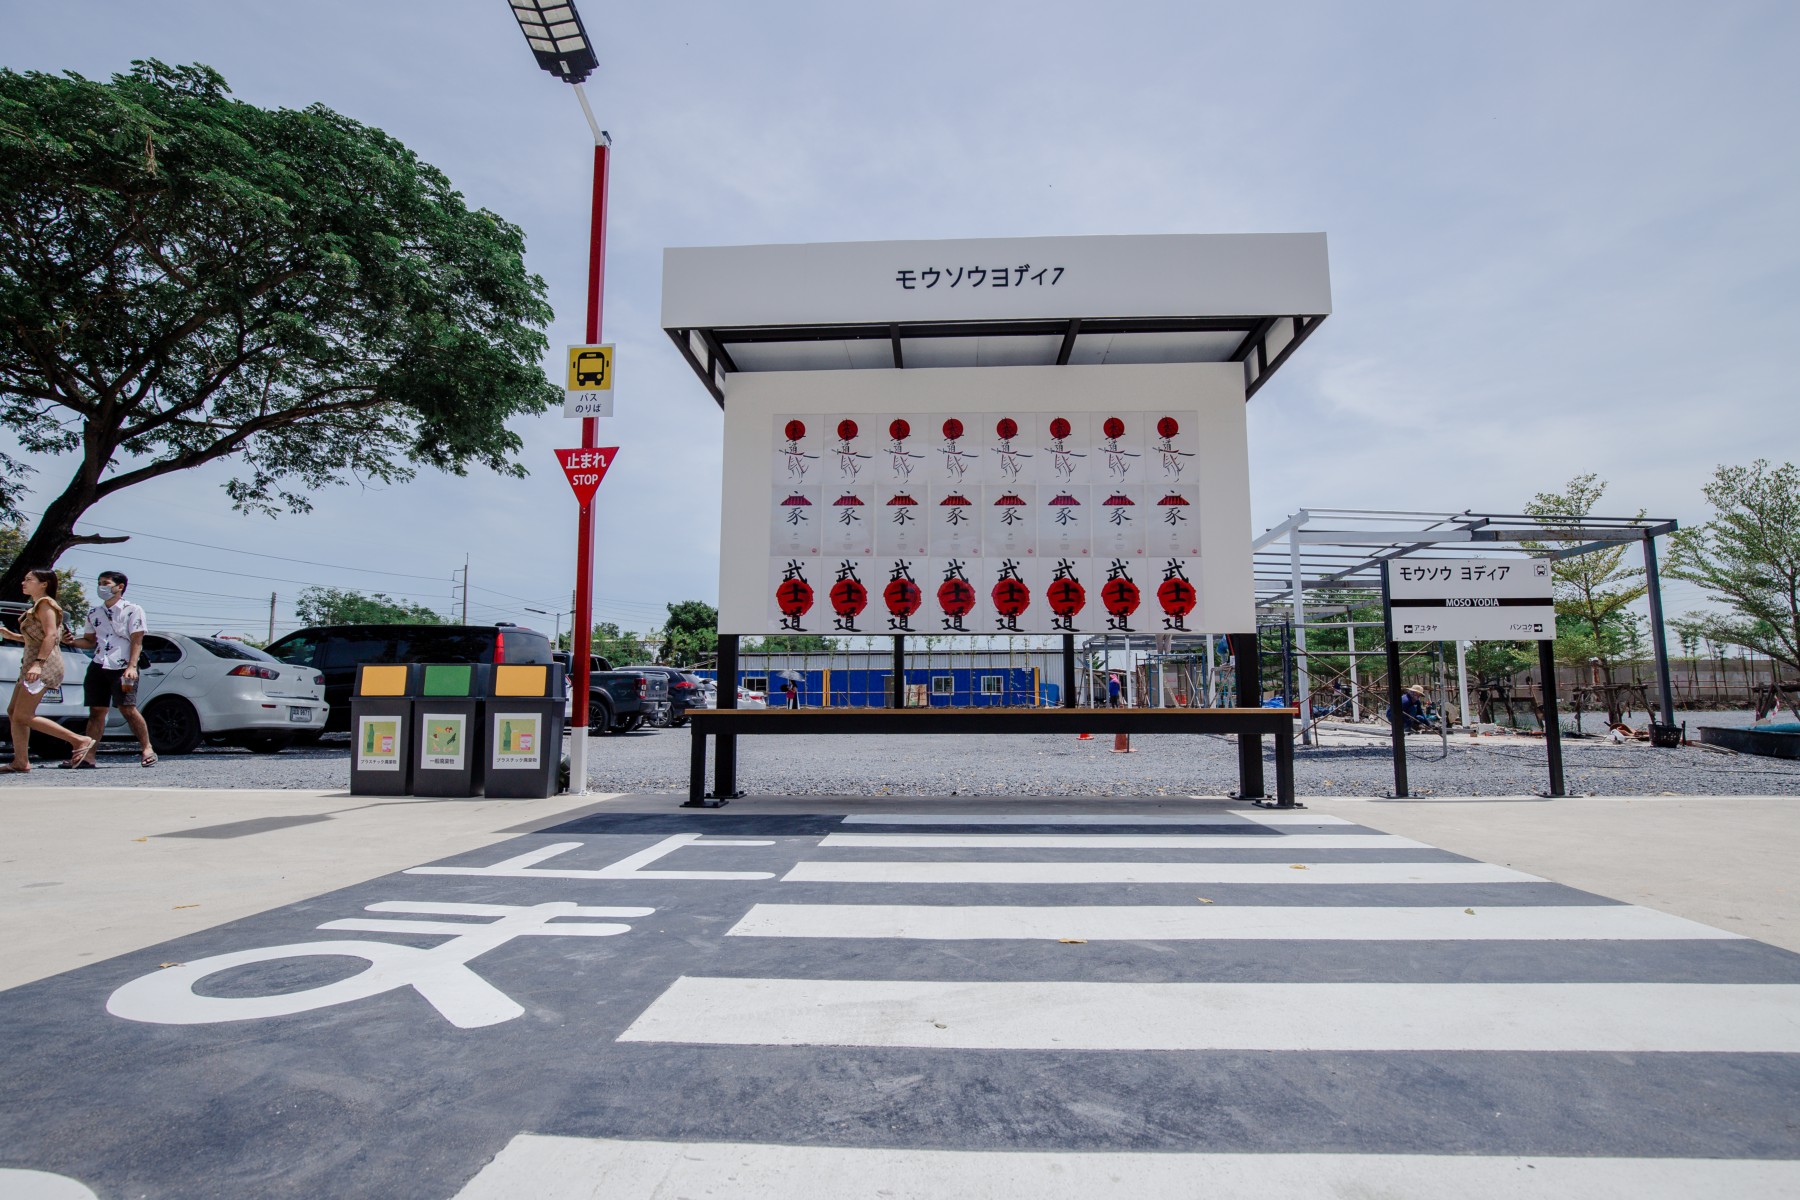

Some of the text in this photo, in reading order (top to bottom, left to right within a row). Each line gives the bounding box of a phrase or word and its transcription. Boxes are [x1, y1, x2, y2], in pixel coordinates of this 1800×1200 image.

[579, 393, 598, 402] バス
[575, 403, 602, 413] のりば
[565, 452, 607, 469] 止まれ
[572, 473, 600, 487] STOP
[1399, 565, 1511, 581] モウソウ ヨディア
[1445, 598, 1500, 607] MOSO YODIA
[1414, 624, 1438, 632] アユタヤ
[1509, 623, 1533, 631] バンコク
